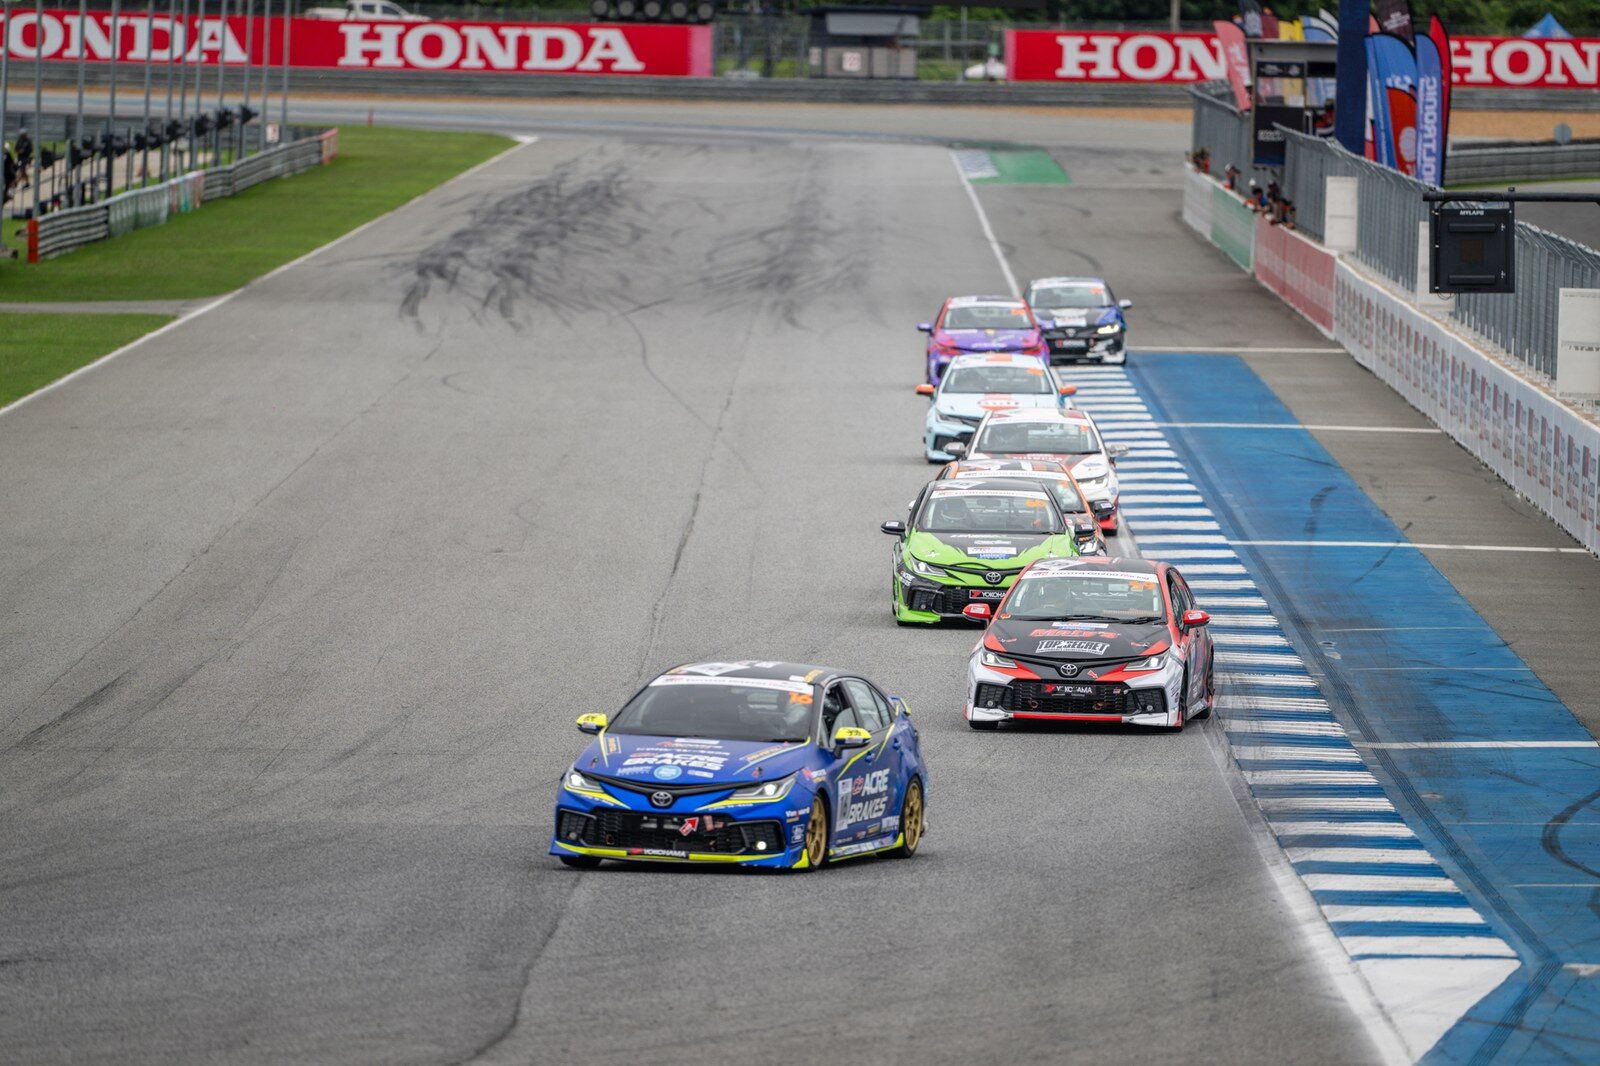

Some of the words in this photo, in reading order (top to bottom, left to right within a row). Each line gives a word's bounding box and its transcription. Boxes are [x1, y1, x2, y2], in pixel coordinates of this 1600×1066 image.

[0, 12, 249, 63] ONDA
[337, 23, 646, 72] HONDA
[1037, 639, 1062, 651] TOP
[1062, 640, 1109, 654] SECRET
[622, 757, 725, 771] BRAKES
[655, 752, 729, 764] ACRE
[861, 768, 890, 797] ACRE
[847, 796, 889, 825] BRAKES
[643, 848, 687, 858] YOKOHAMA
